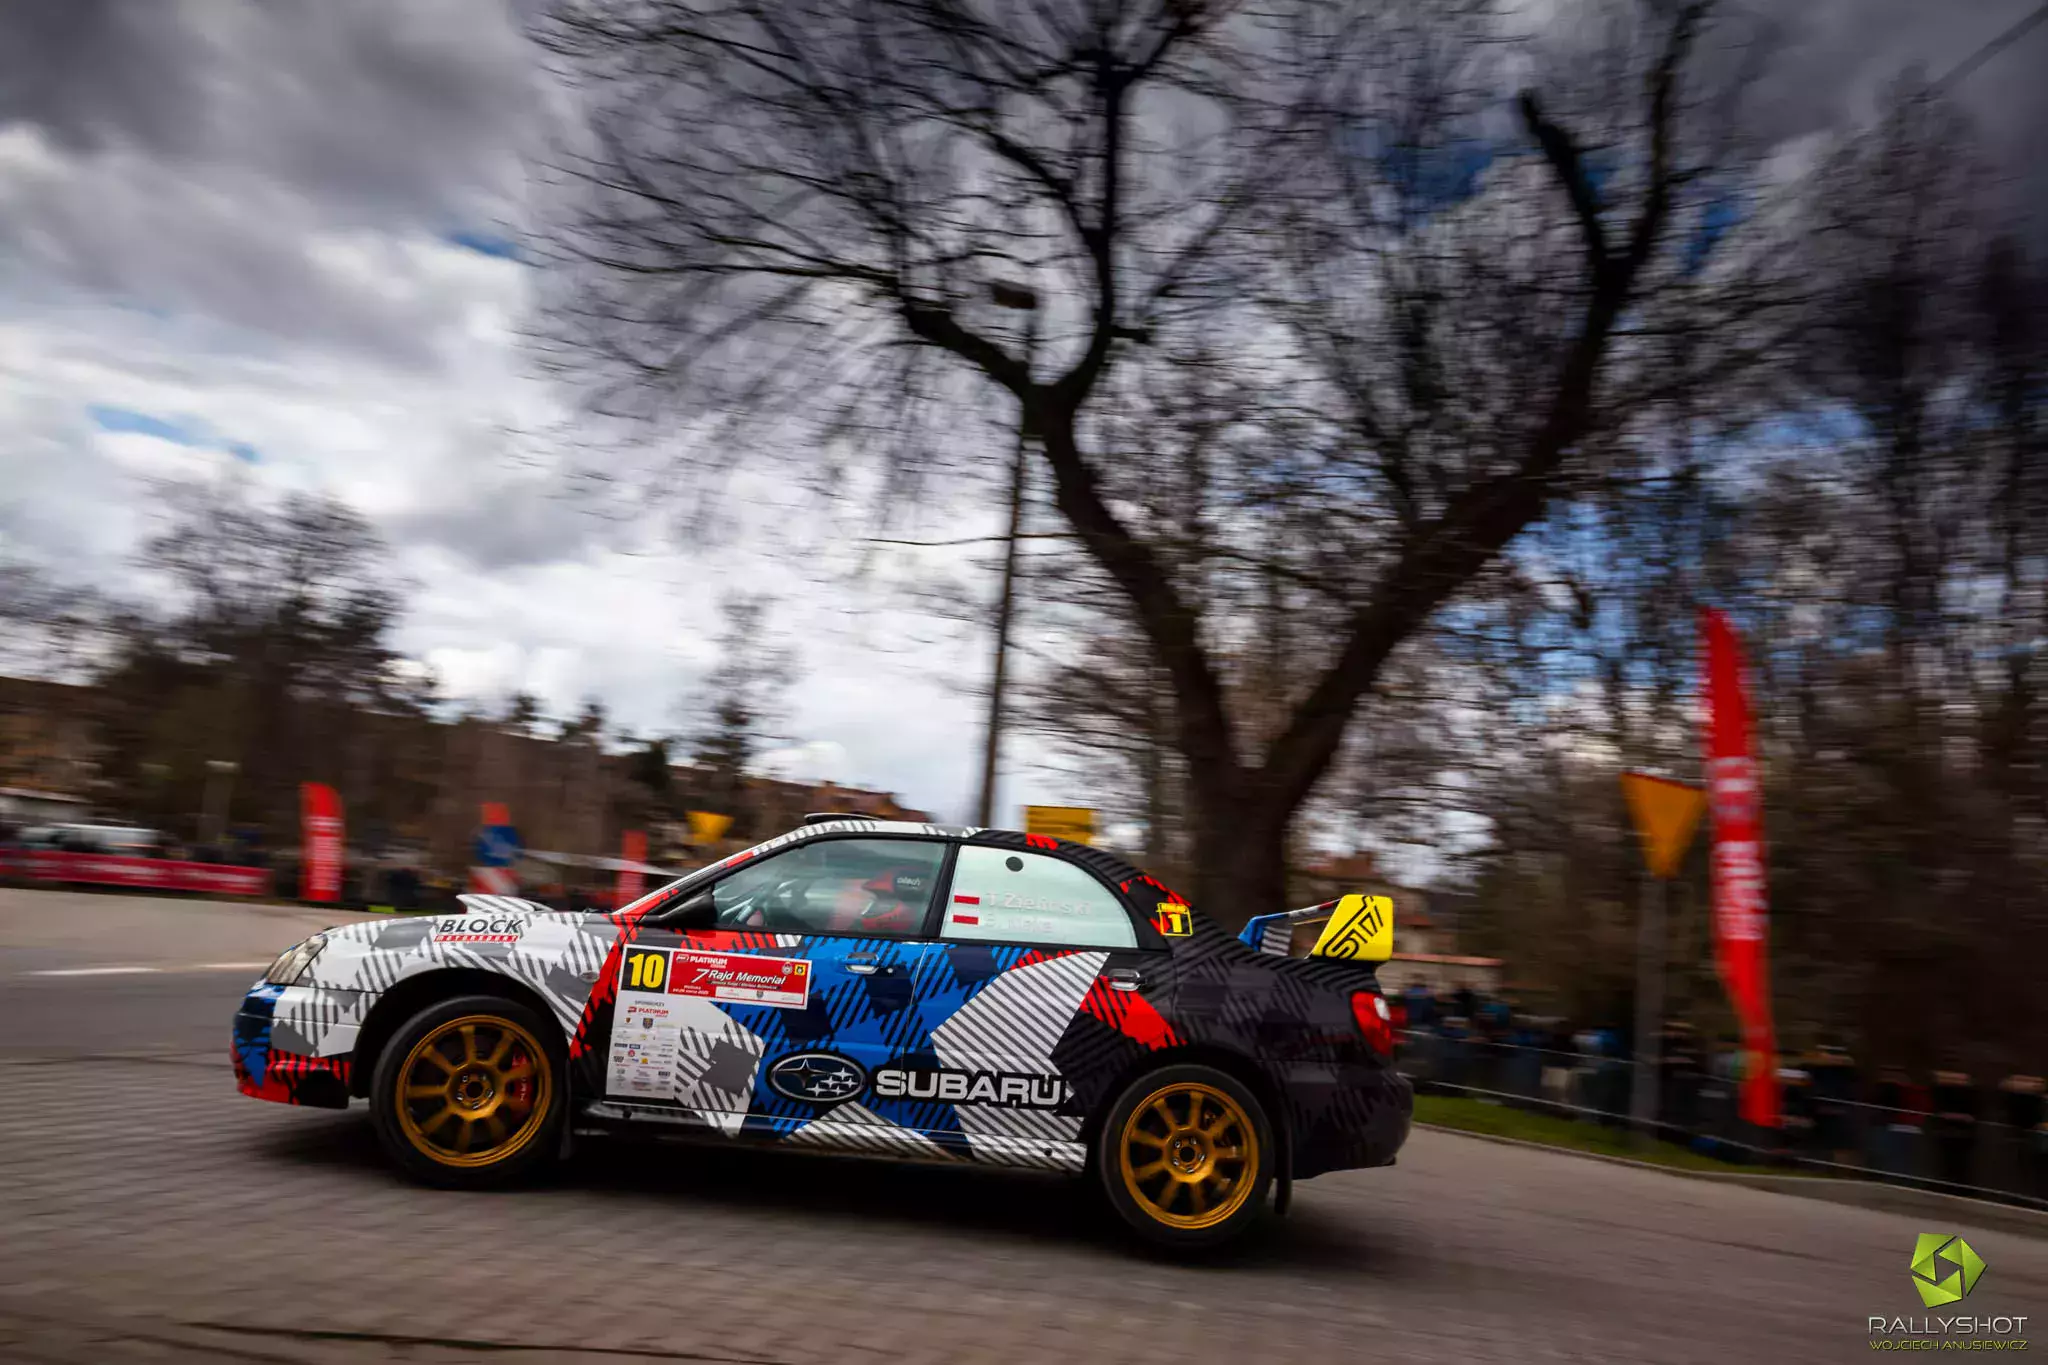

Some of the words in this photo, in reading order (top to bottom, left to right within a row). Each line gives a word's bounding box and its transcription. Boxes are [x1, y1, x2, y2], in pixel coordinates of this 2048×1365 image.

[440, 919, 523, 933] BLOCK
[1167, 913, 1182, 933] 1
[690, 956, 728, 967] PLATINUM
[628, 953, 665, 988] 10
[692, 968, 710, 983] 7
[708, 970, 734, 980] Rajd
[736, 972, 786, 985] Memorial
[638, 1007, 669, 1015] PLATINUM
[876, 1070, 1061, 1105] SUBARU
